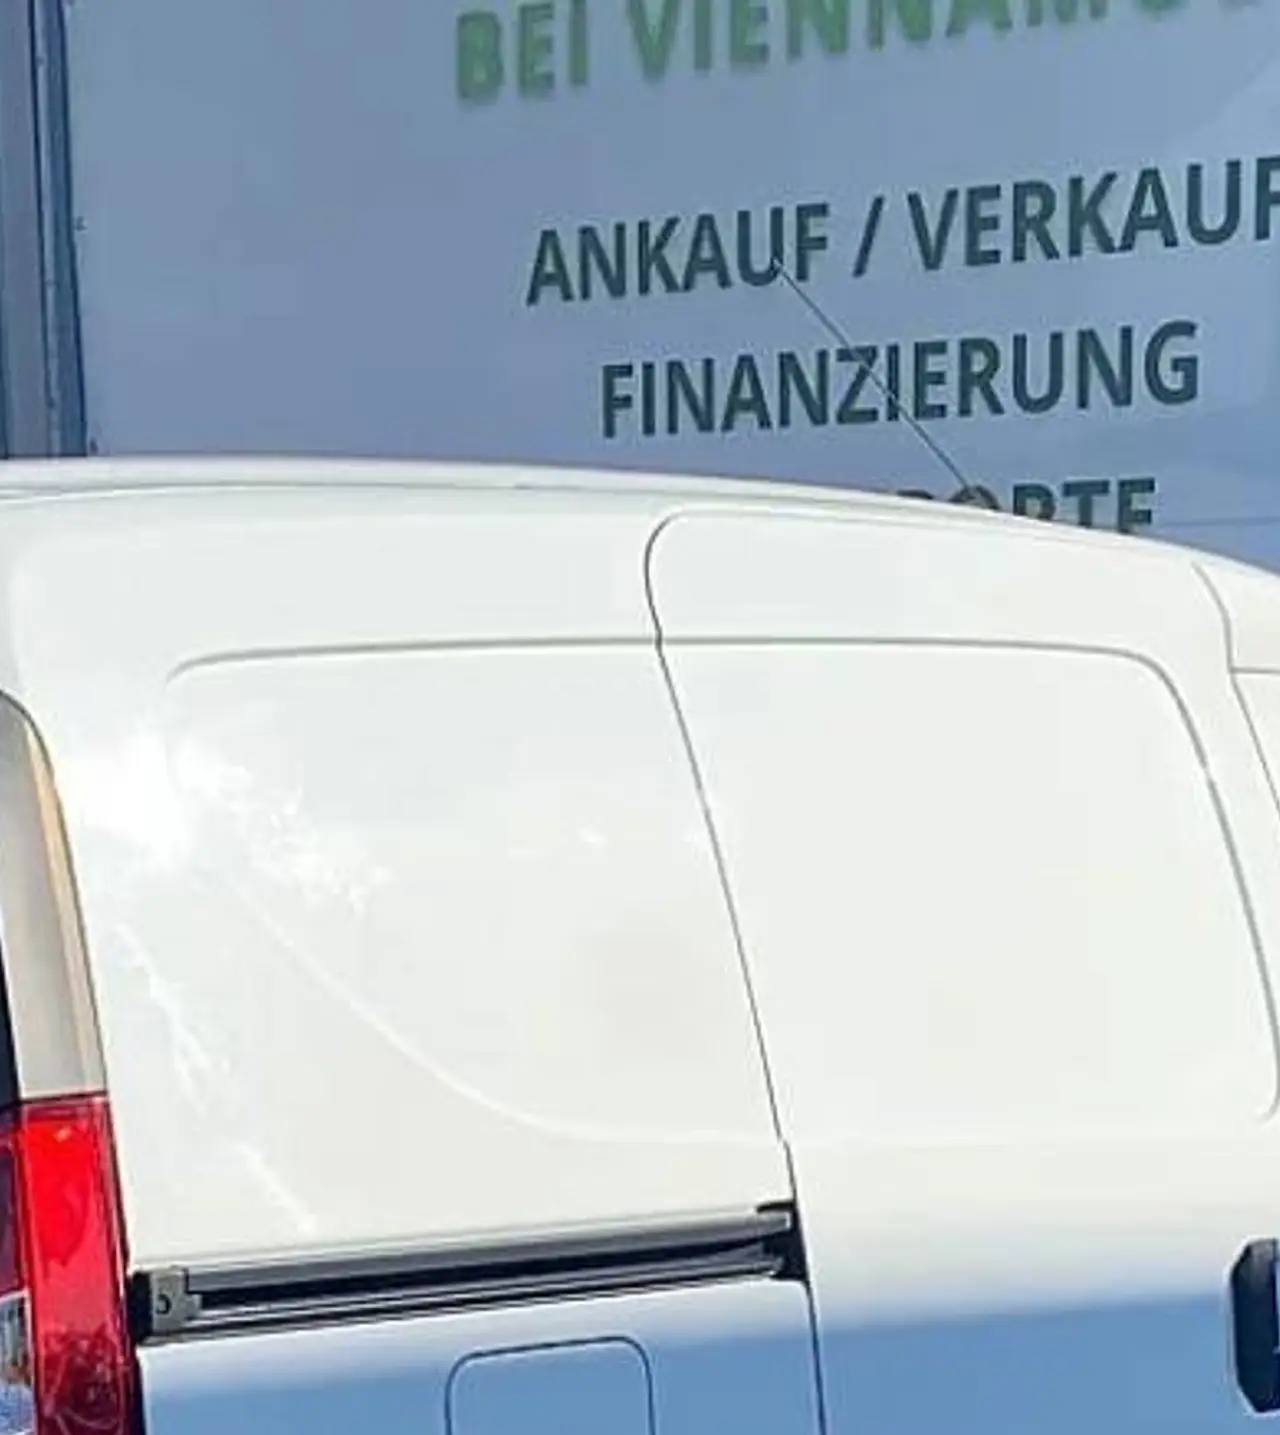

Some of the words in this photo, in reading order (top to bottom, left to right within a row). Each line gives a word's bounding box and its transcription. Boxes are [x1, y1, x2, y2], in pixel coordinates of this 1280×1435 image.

[455, 0, 589, 104] BEI
[525, 201, 830, 308] ANKAUF
[851, 194, 885, 278] /
[602, 320, 1198, 440] FINANZIERUNG
